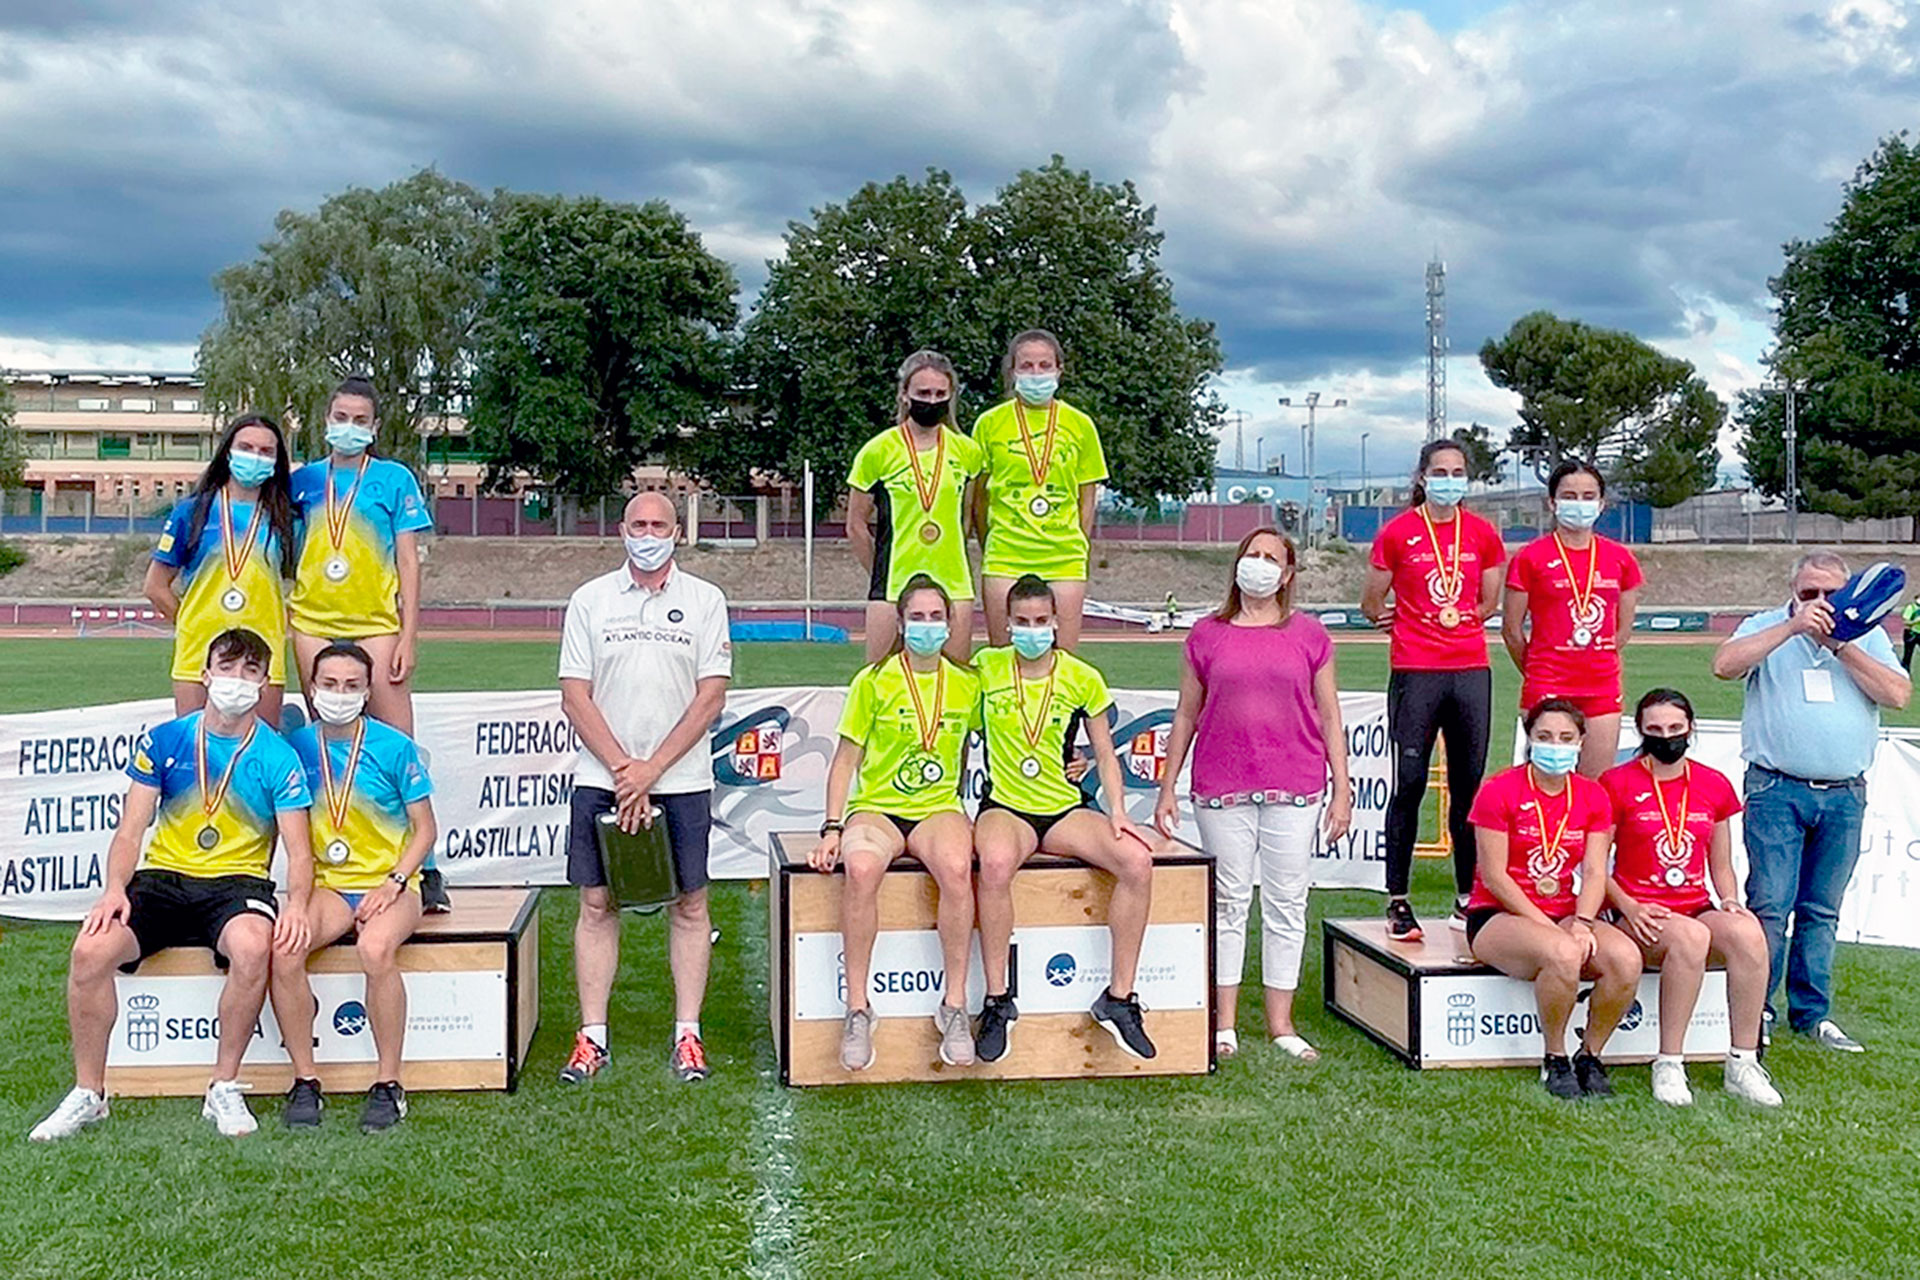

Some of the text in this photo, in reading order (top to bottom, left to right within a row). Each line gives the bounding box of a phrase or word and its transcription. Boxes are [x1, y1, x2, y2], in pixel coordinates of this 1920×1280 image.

[604, 631, 692, 646] ATLANTIC OCEAN
[446, 825, 541, 859] CASTILLA
[546, 824, 560, 857] Y
[0, 853, 102, 896] ASTILLA
[873, 970, 944, 993] SEGOV
